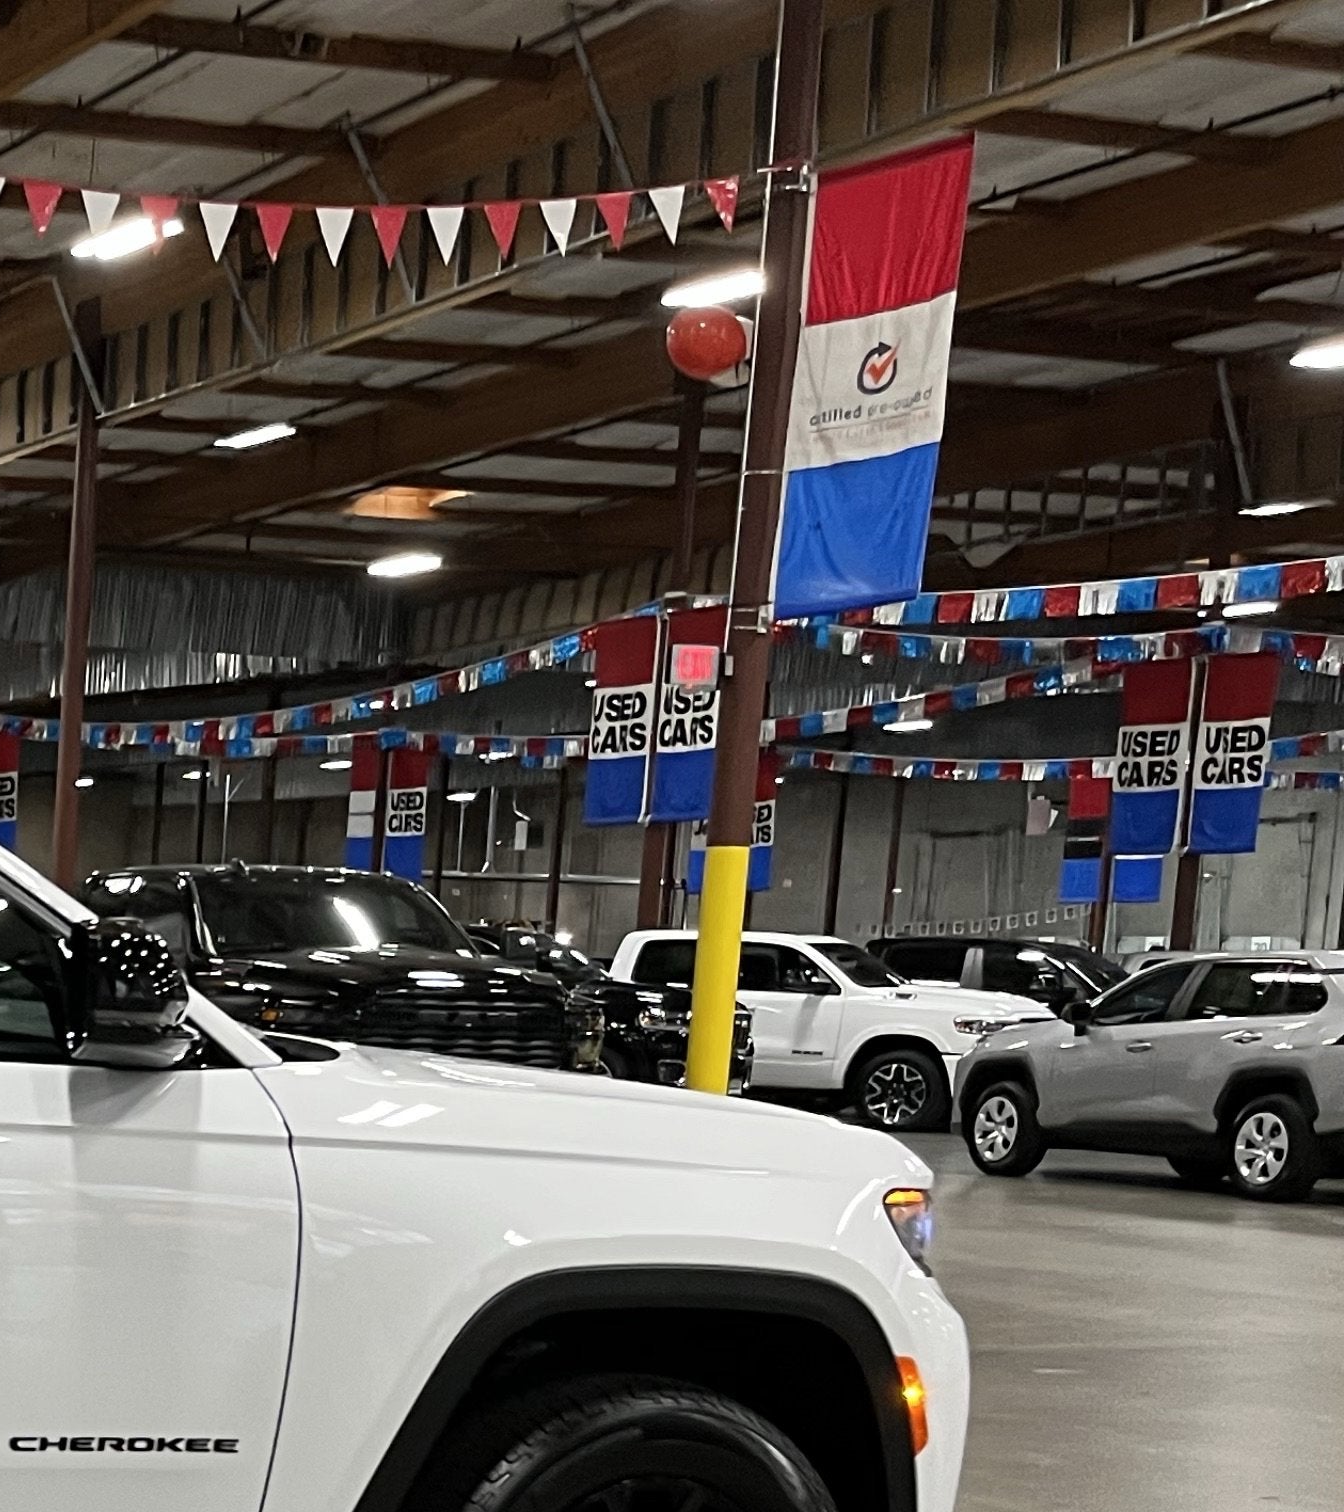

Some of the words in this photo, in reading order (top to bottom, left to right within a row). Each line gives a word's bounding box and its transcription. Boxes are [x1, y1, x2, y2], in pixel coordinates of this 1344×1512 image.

[594, 691, 647, 722] USED
[591, 723, 647, 753] CARS
[658, 715, 714, 747] CARS
[1121, 729, 1181, 757] USED
[1117, 759, 1178, 787] CARS
[8, 1436, 240, 1454] CHEROKEE
